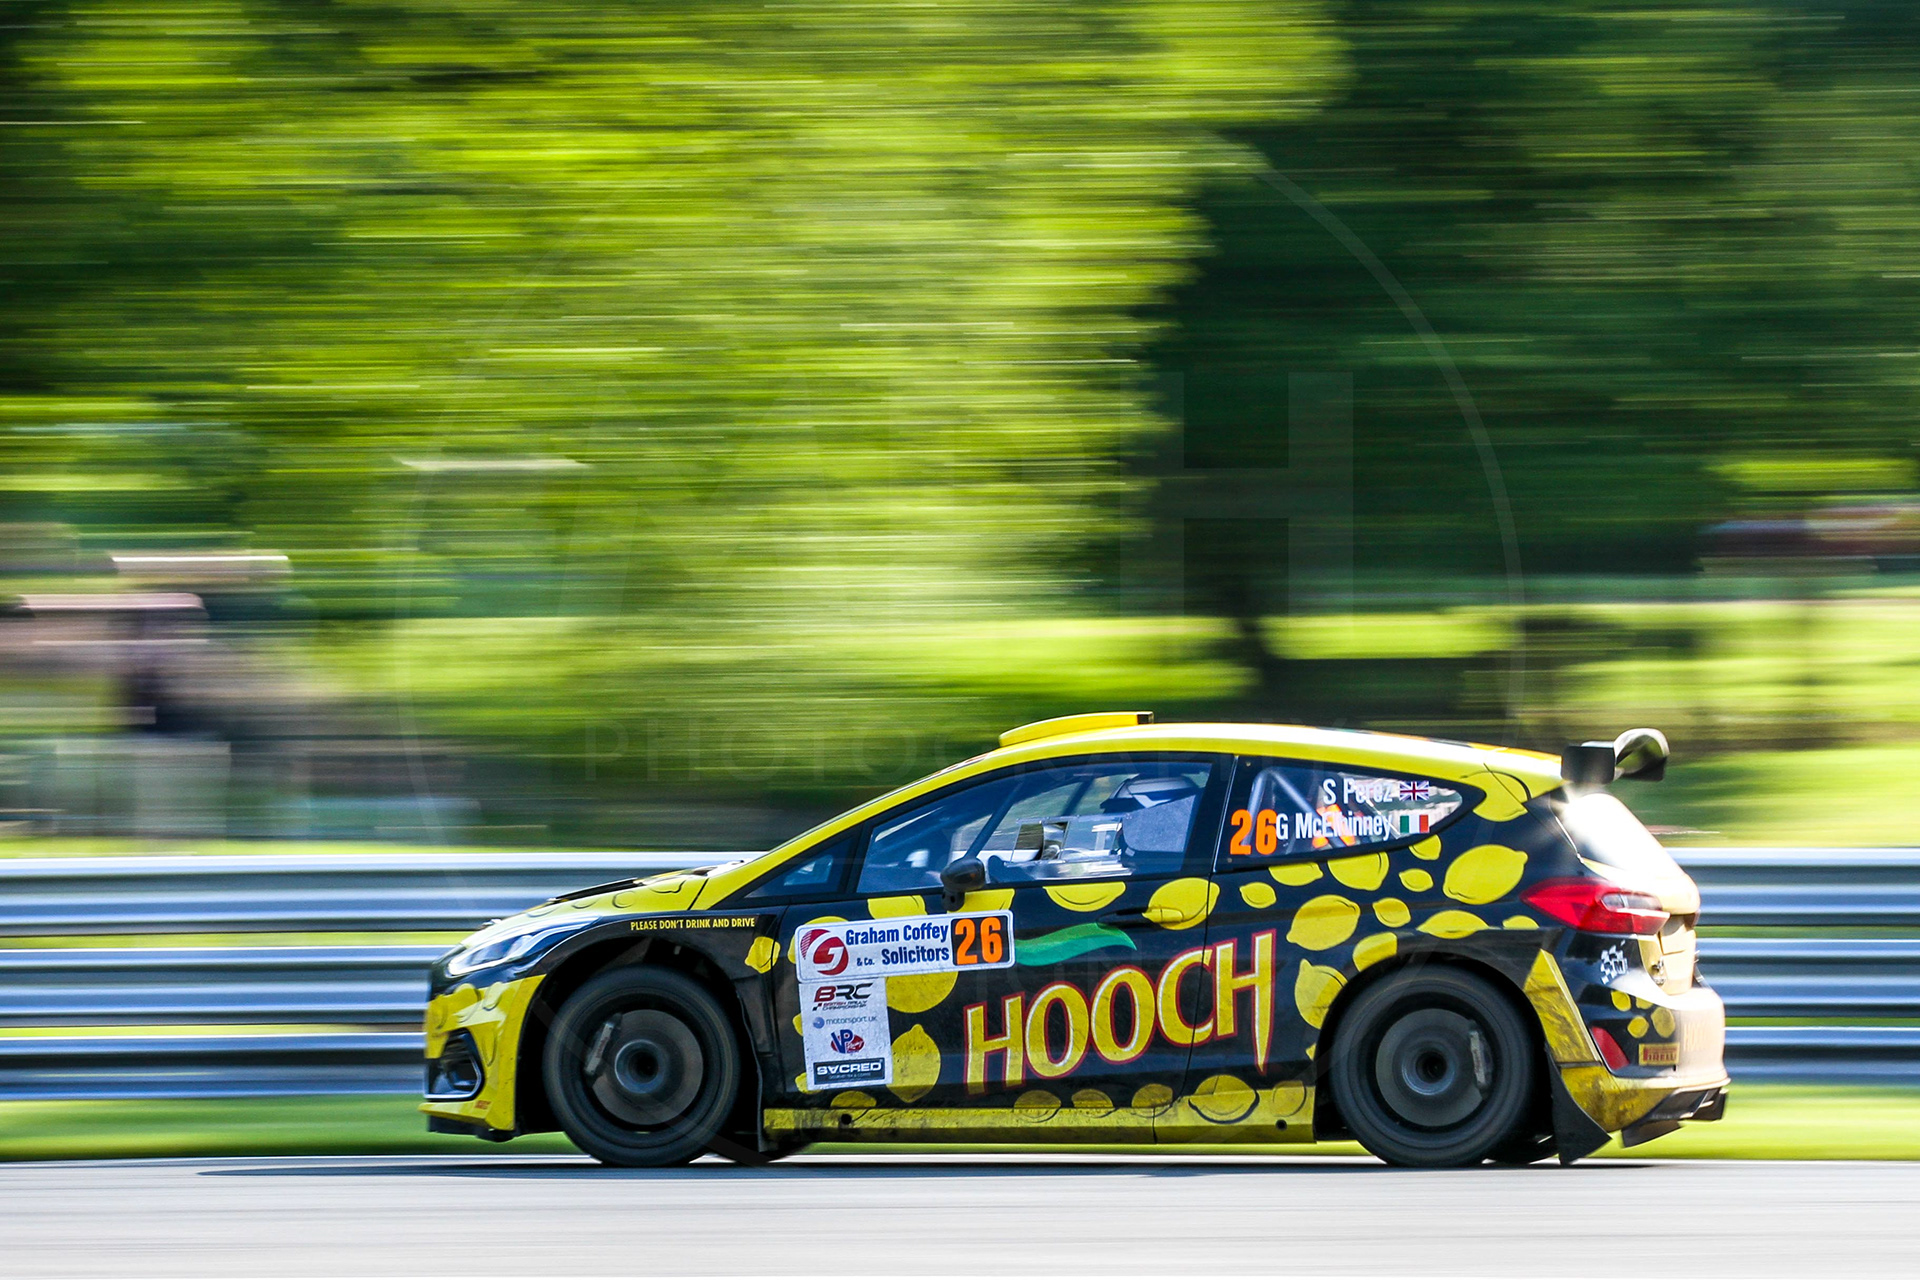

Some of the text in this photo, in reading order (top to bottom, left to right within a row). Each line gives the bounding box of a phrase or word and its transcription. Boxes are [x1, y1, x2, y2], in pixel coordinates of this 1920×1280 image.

[1323, 777, 1393, 804] S Perez
[1229, 809, 1278, 855] 26
[1276, 812, 1289, 840] G
[630, 918, 755, 931] PLEASE DON'T DRINK AND DRIVE
[845, 922, 949, 945] Graham Coffey
[954, 917, 1003, 965] 26
[856, 945, 950, 967] & Co. Solicitors
[814, 983, 873, 1002] BRC
[826, 1016, 867, 1025] motorsport
[964, 929, 1277, 1095] HOOCH
[830, 1029, 854, 1054] VP
